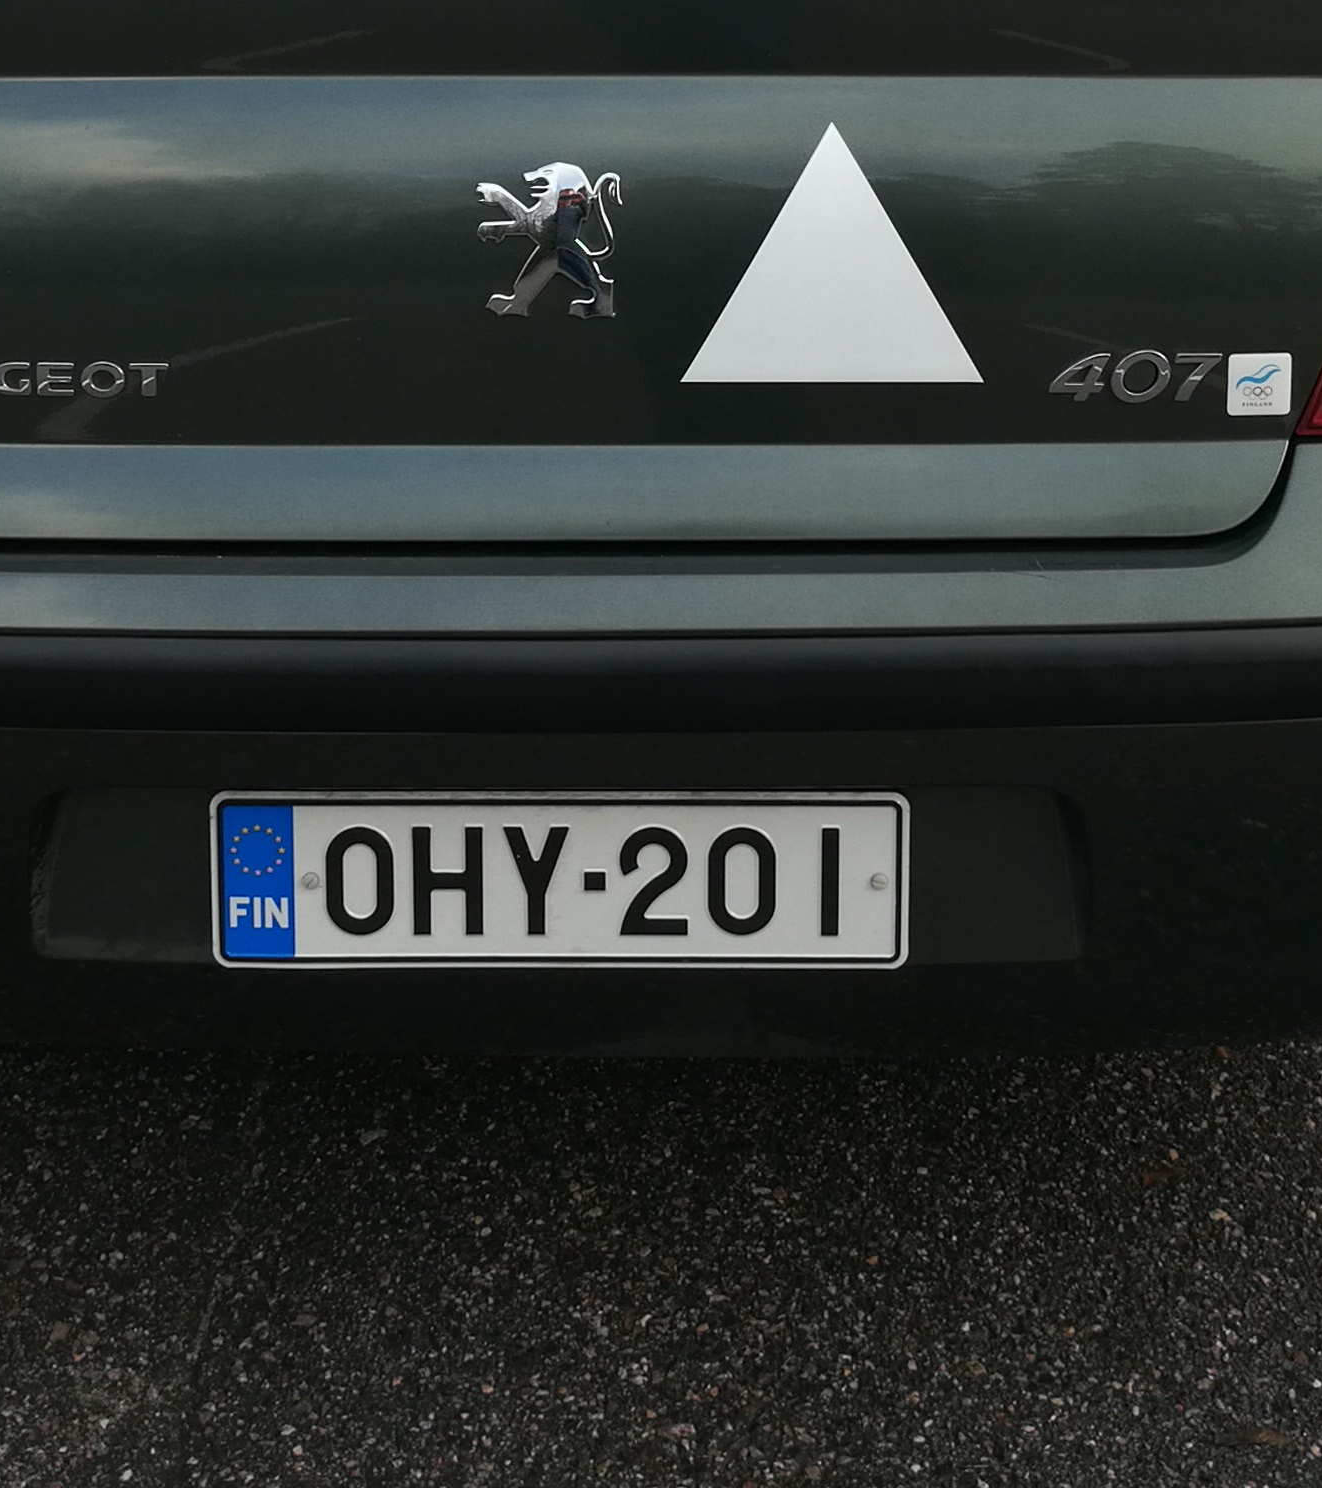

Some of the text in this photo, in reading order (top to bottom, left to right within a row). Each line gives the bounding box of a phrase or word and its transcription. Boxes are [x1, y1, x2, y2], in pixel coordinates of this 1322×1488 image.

[1048, 349, 1224, 403] 407
[325, 826, 841, 936] OHY-201
[229, 895, 289, 929] FIN
